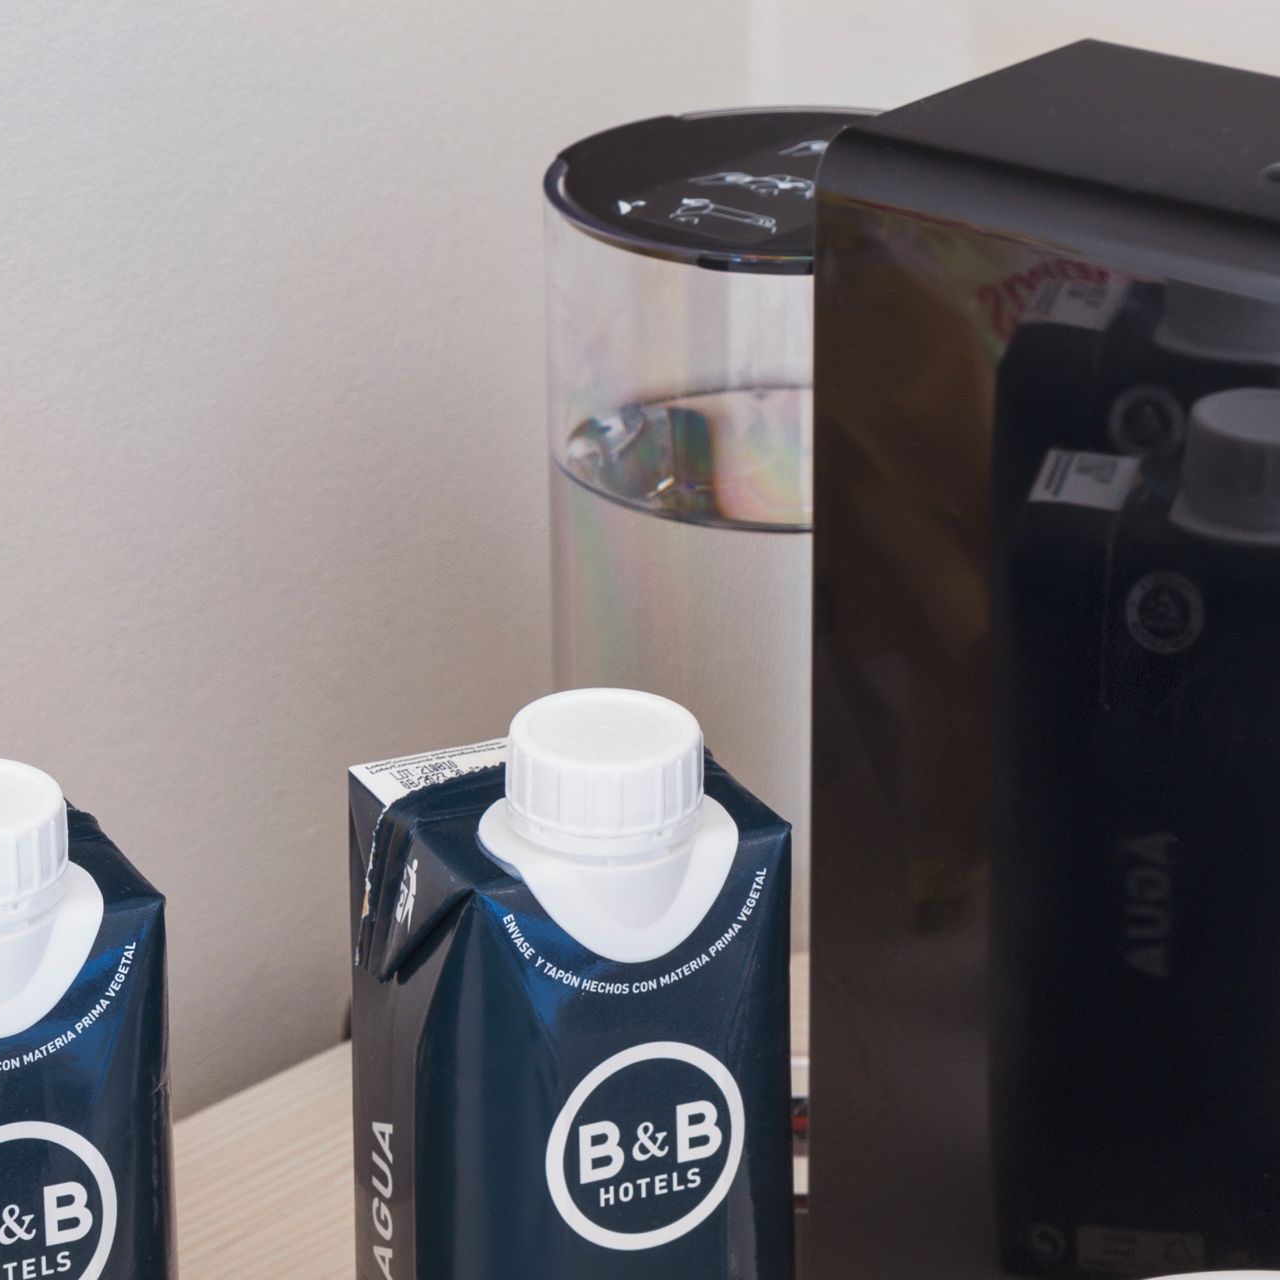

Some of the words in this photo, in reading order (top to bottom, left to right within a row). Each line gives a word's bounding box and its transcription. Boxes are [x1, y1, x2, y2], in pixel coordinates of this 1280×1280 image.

[503, 913, 535, 960] ENVASE
[534, 956, 546, 968] Y
[543, 962, 581, 988] TAPÓN
[581, 979, 630, 994] HECHOS
[632, 979, 658, 994] CON
[659, 954, 711, 987] MATERIA
[708, 922, 743, 958] PRIMA
[737, 867, 767, 922] VEGETAL
[23, 1030, 77, 1065] MATERIA
[74, 998, 110, 1034] PRIMA
[105, 941, 136, 998] VEGETAL
[599, 1168, 702, 1207] HOTELS
